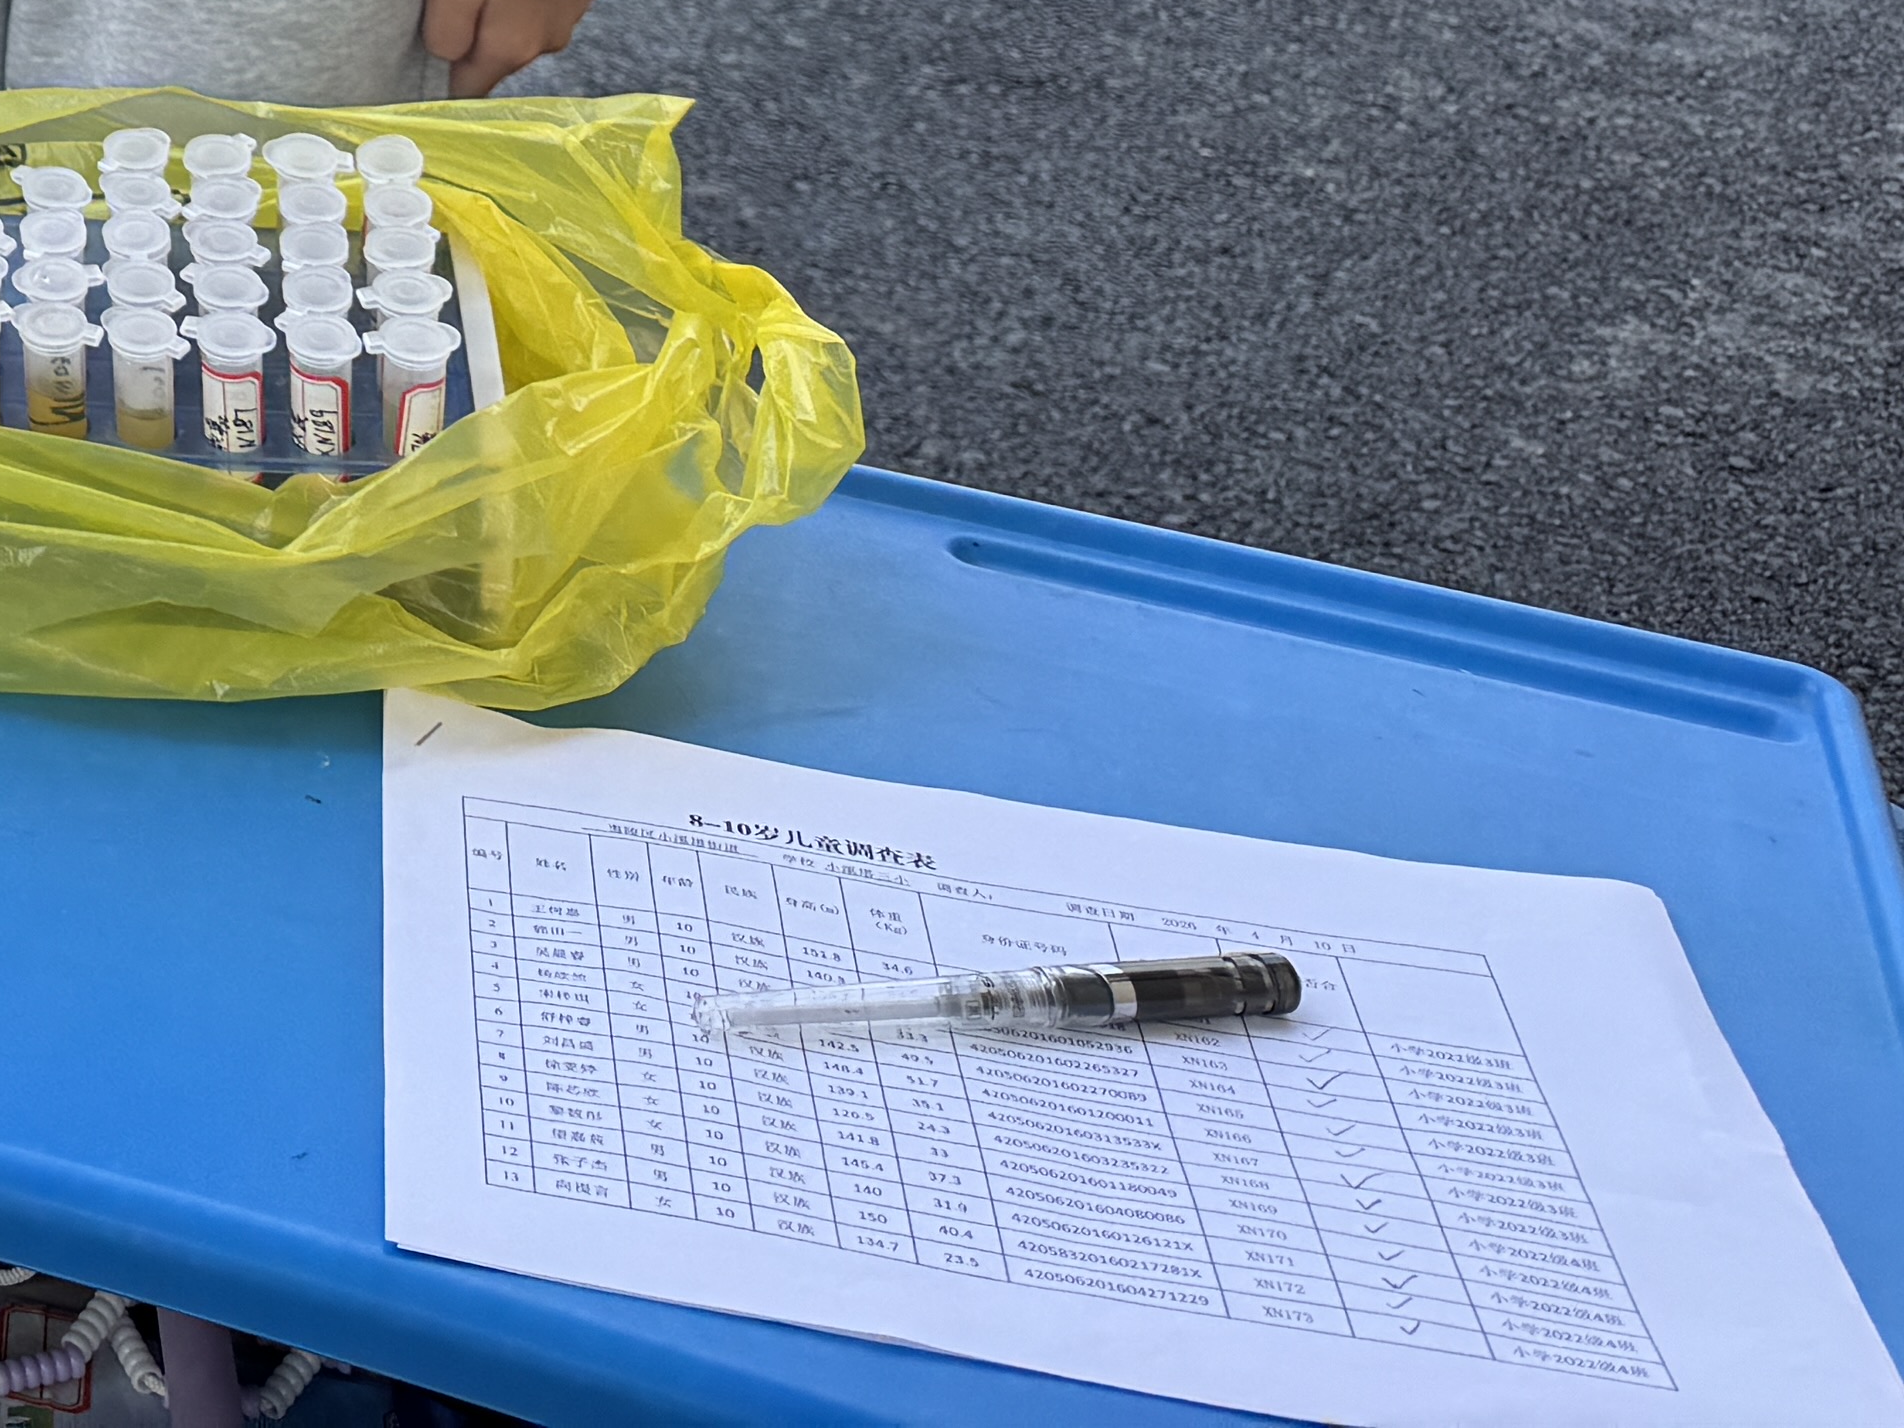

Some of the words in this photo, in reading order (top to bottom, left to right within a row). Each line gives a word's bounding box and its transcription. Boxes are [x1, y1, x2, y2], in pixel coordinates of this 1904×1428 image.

[233, 408, 257, 449] N187
[676, 921, 693, 933] 10
[679, 944, 697, 955] 10
[1279, 934, 1294, 946] 月
[1342, 943, 1357, 954] 日
[683, 966, 700, 978] 10
[496, 1029, 504, 1039] 7
[695, 1056, 713, 1068] 10
[692, 1032, 710, 1045] 10
[698, 1079, 717, 1091] 10
[498, 1096, 515, 1107] 10
[705, 1129, 724, 1141] 10
[702, 1104, 720, 1116] 10
[499, 1119, 515, 1131] 11
[709, 1155, 727, 1167] 10
[853, 1183, 884, 1197] 140
[501, 1145, 519, 1157] 12
[712, 1181, 732, 1193] 10
[858, 1209, 889, 1225] 150
[503, 1170, 520, 1182] 13
[716, 1206, 736, 1219] 10
[856, 1235, 900, 1253] 134.7
